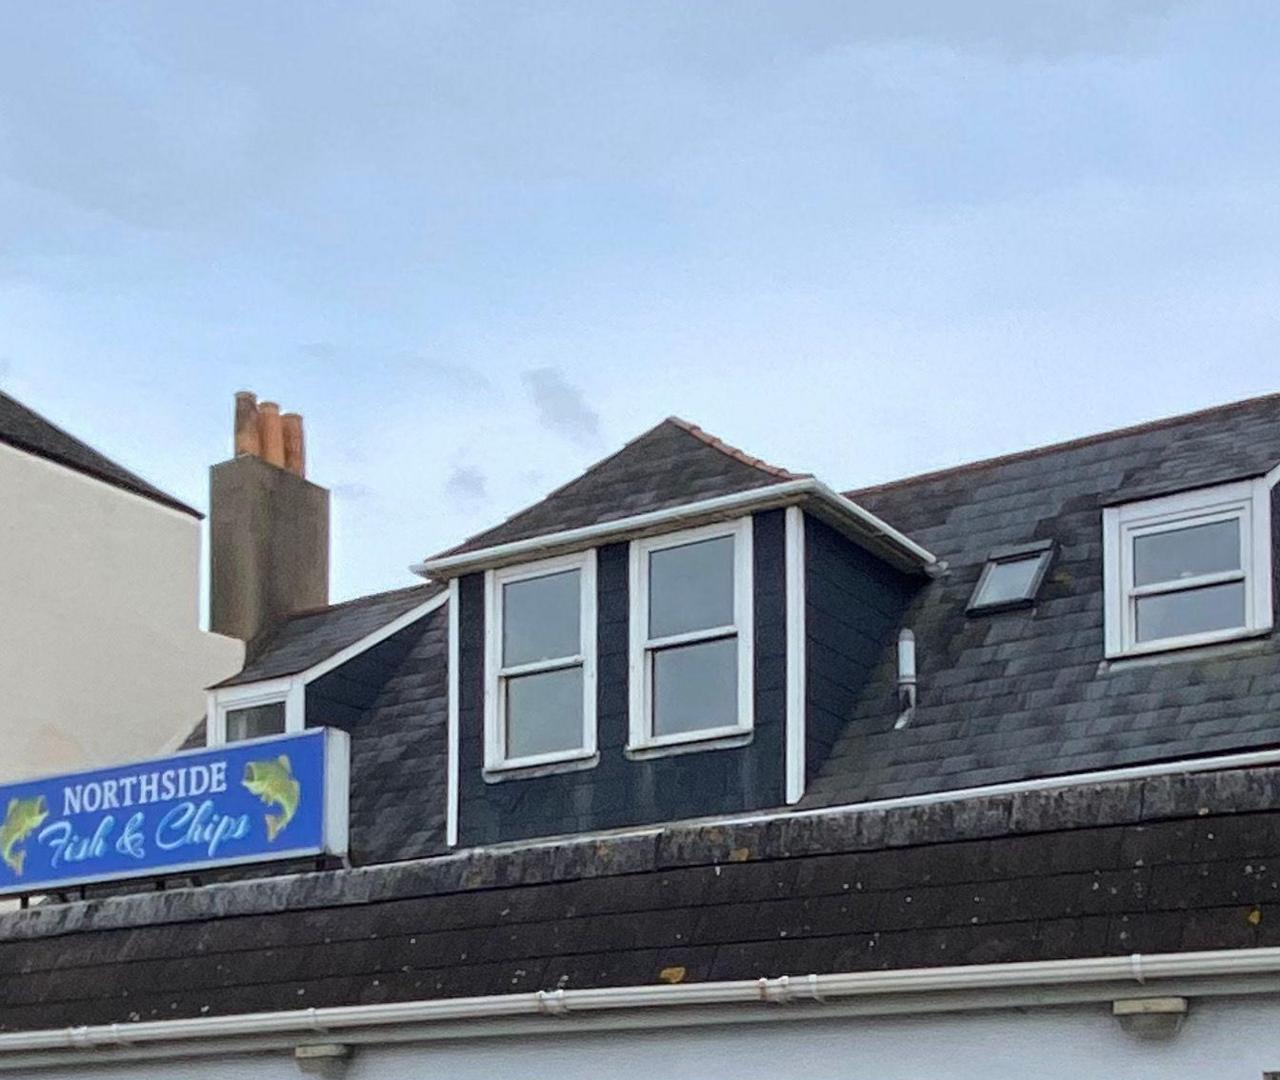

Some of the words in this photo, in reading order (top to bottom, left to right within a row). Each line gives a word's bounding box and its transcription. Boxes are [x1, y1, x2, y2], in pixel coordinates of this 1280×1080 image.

[62, 761, 228, 816] NORTHSIDE
[38, 815, 116, 869] Fish
[116, 811, 146, 859] &
[155, 799, 252, 858] Chips
